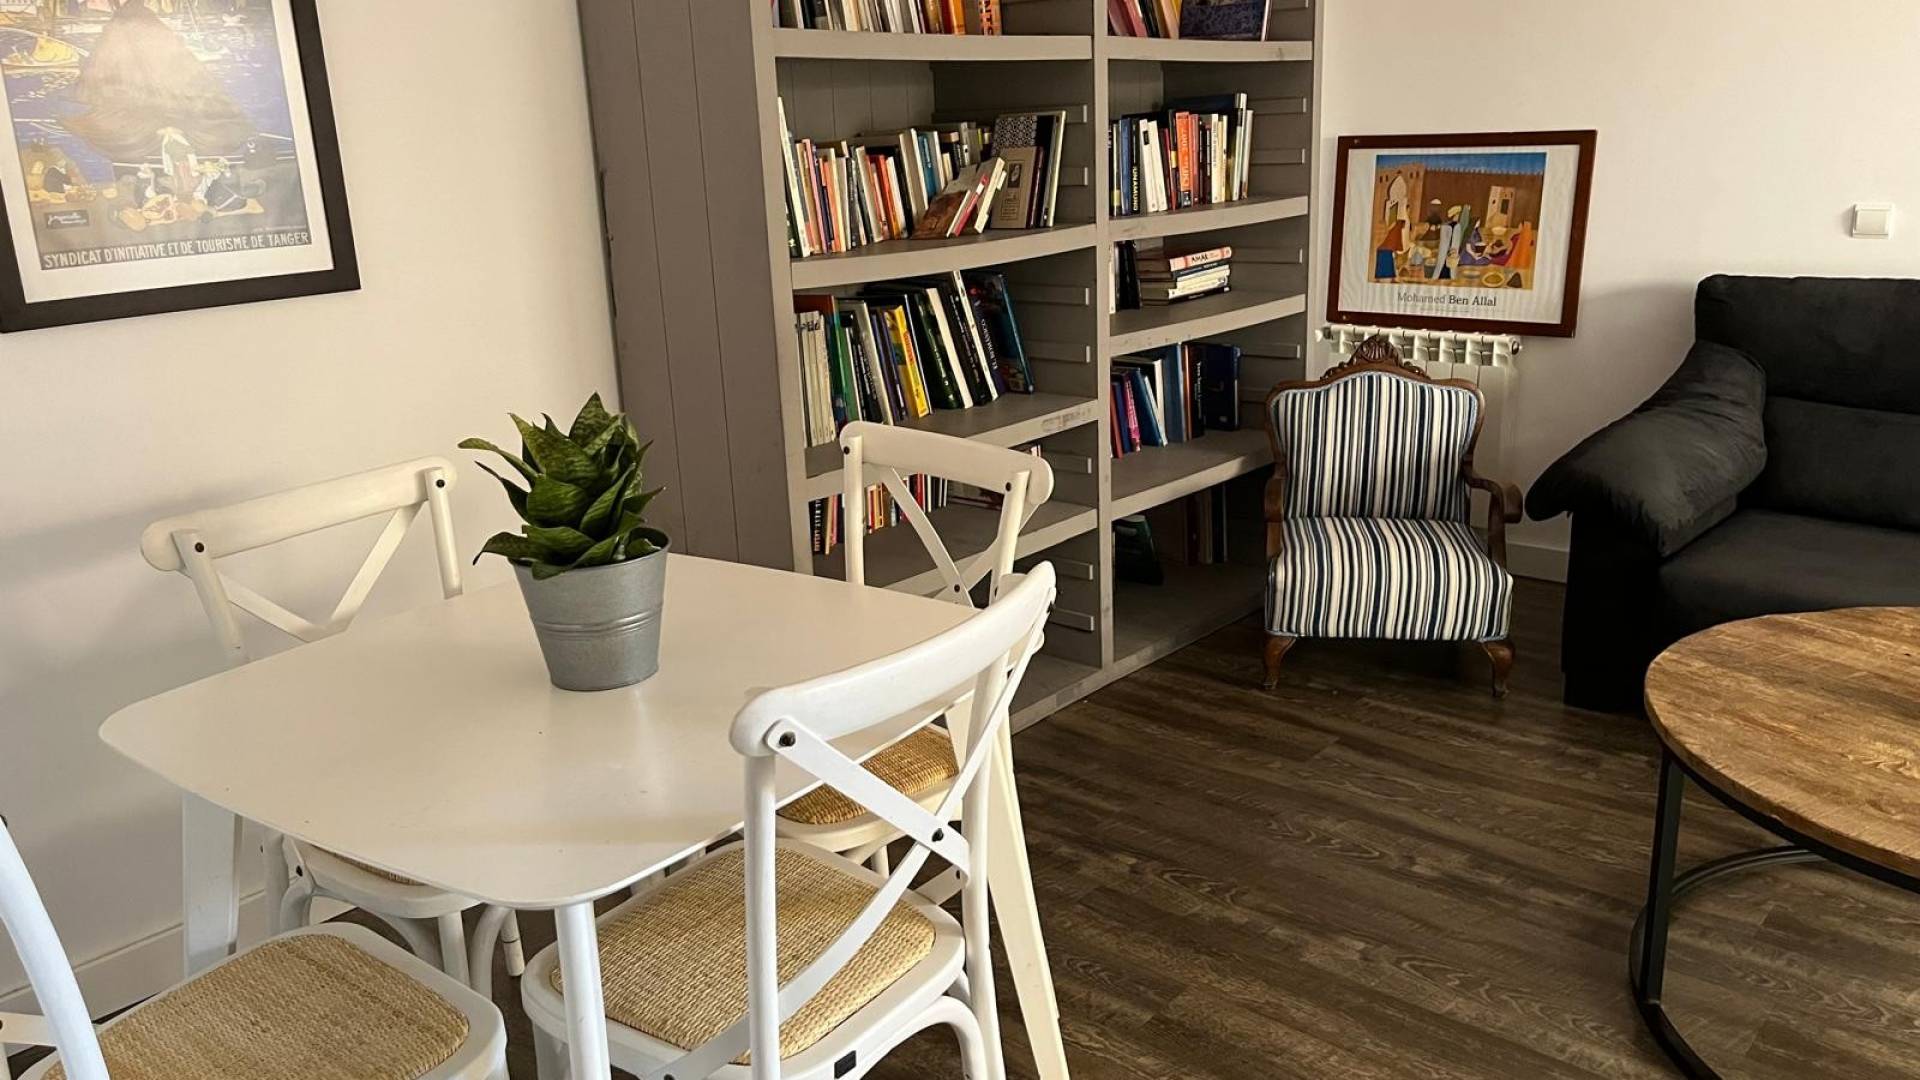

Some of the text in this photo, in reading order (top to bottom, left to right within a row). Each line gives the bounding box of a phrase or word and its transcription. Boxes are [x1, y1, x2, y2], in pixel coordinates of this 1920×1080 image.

[44, 232, 308, 268] SYNDICAT D'INITIATIVE ET DE TOURISME DE TANGER
[1398, 292, 1497, 307] Mohamed Ben Allal
